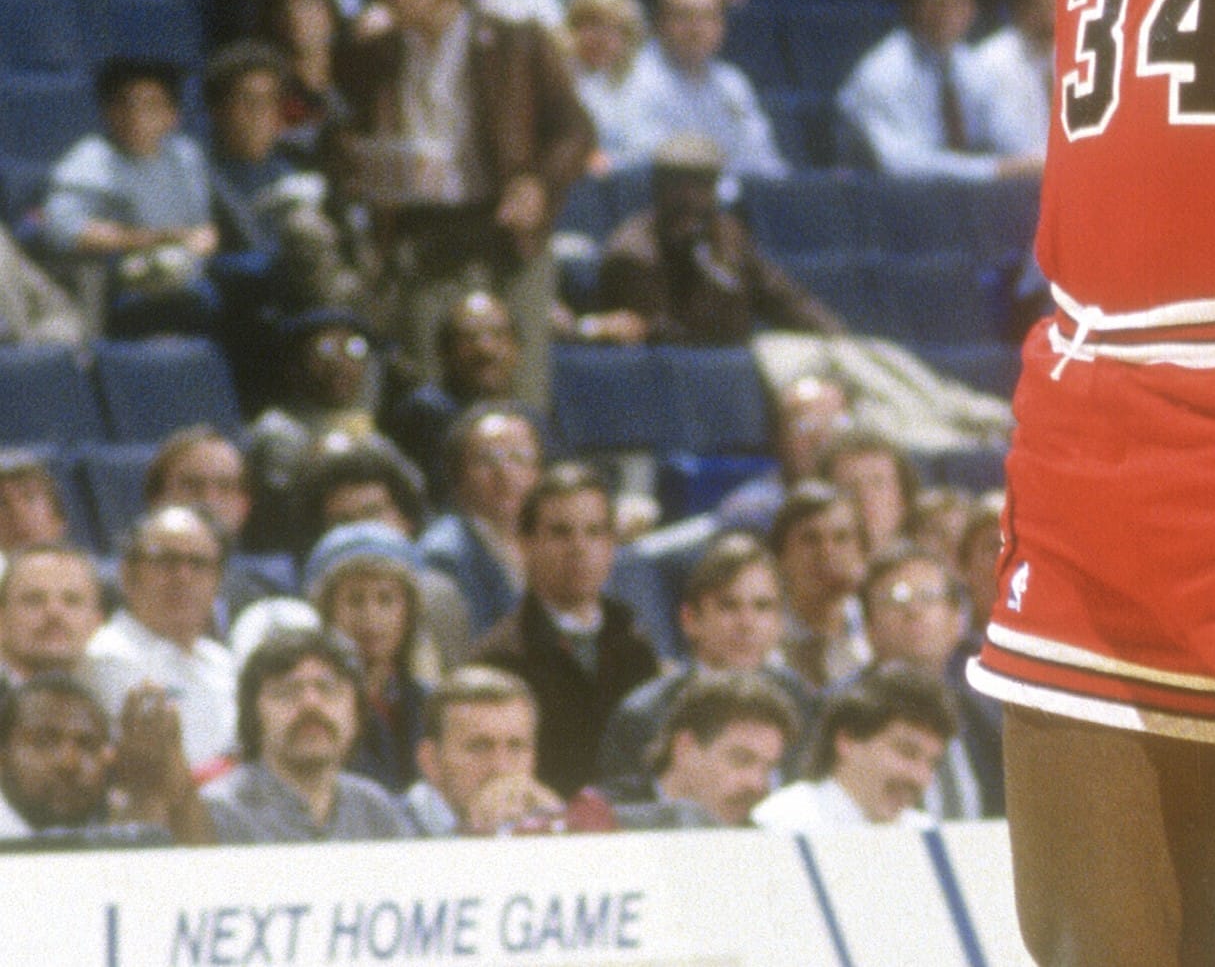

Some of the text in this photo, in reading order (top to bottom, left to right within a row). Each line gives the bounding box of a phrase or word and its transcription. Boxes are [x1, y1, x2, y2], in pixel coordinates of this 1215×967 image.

[171, 889, 646, 967] NEXT HOME GAME
